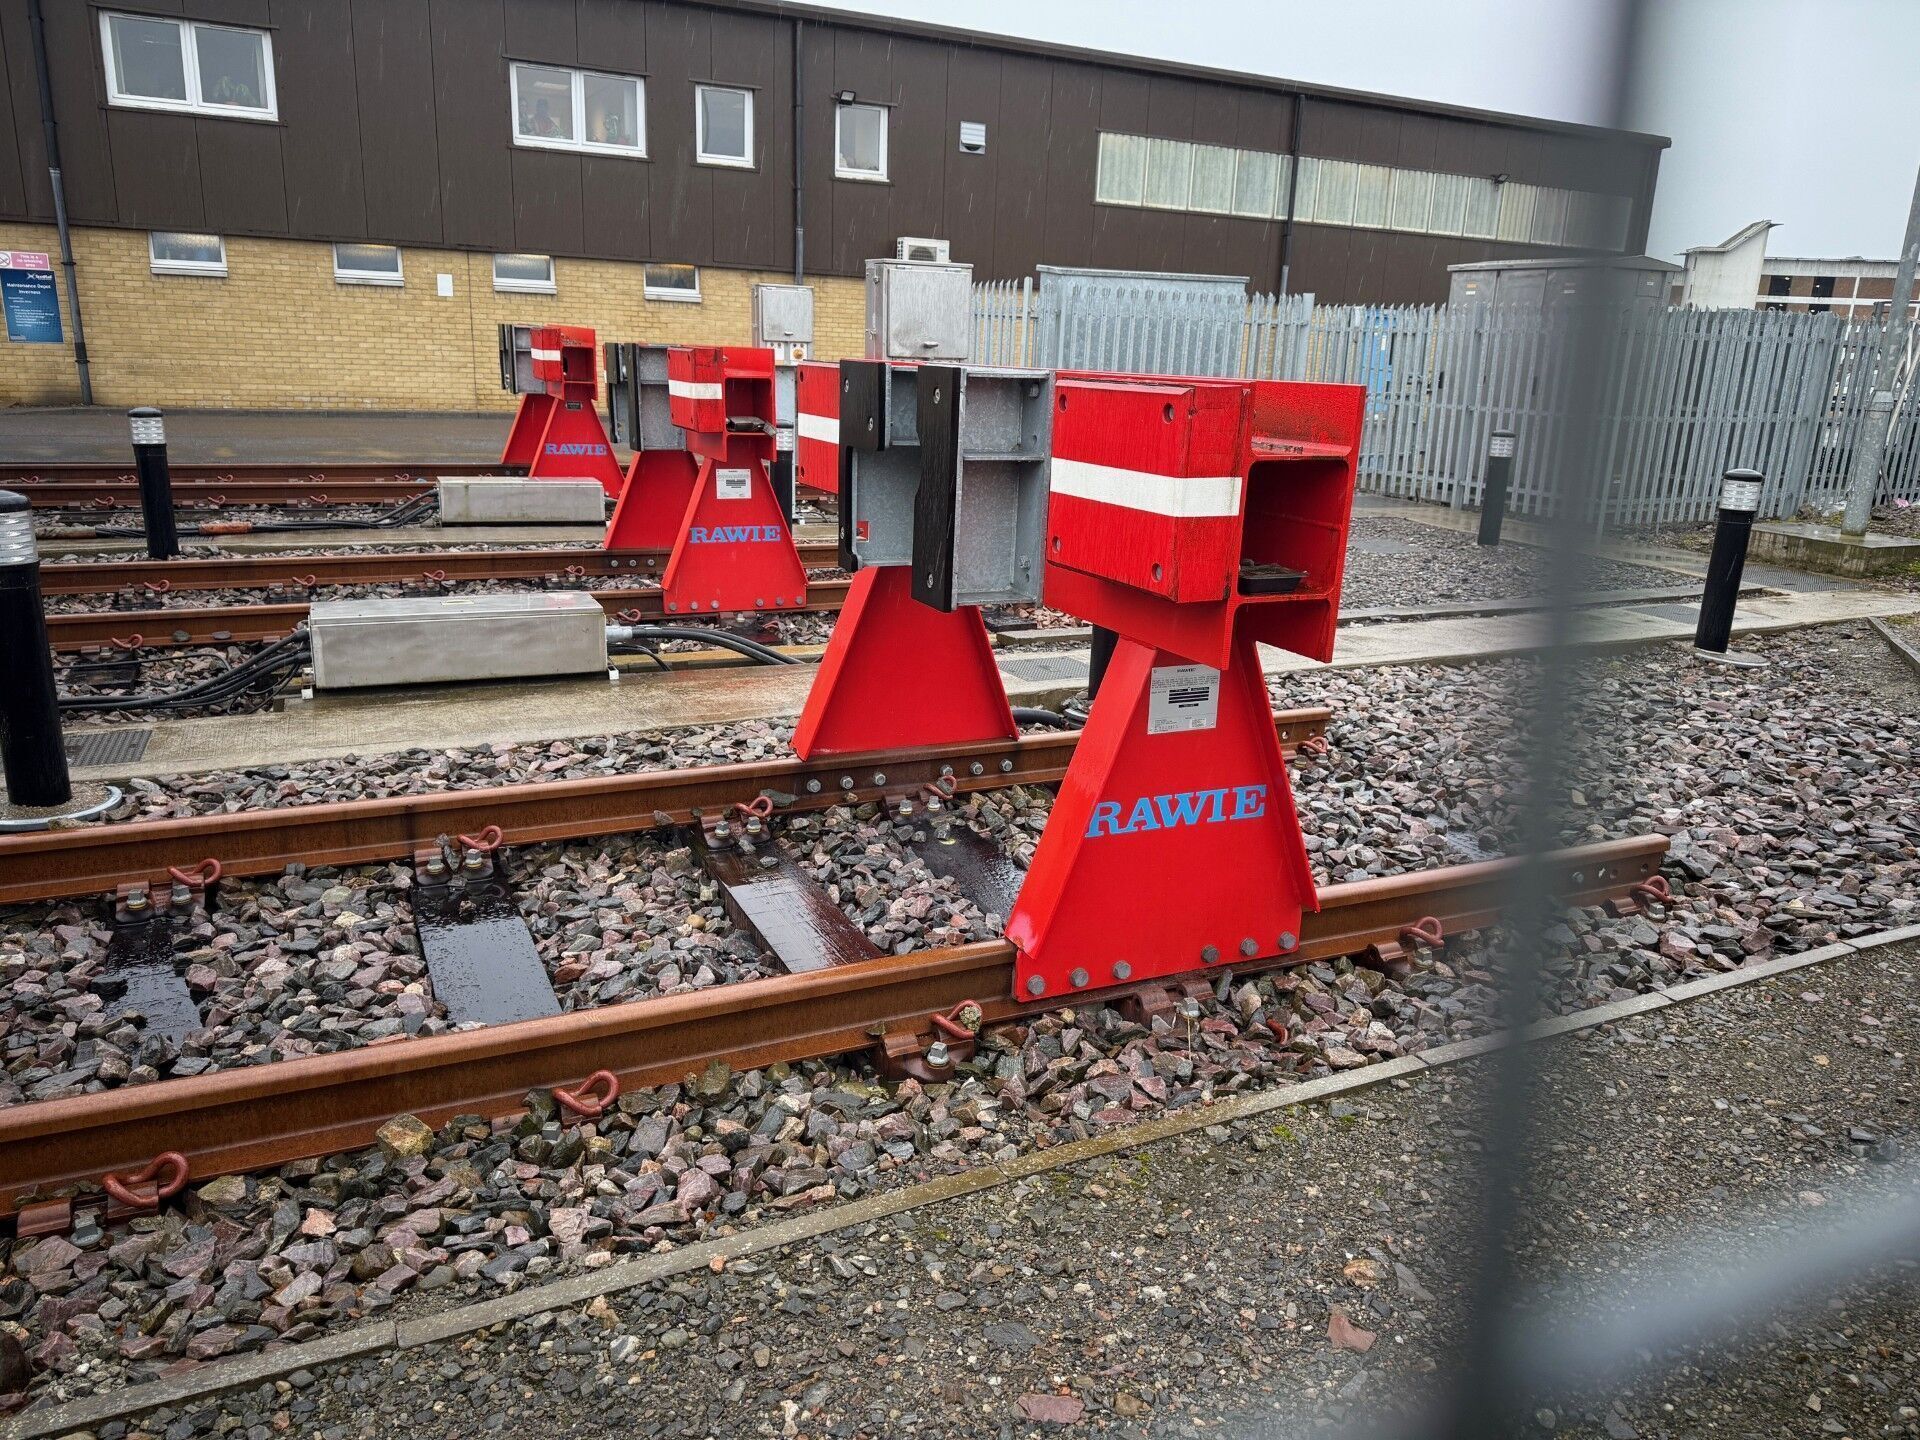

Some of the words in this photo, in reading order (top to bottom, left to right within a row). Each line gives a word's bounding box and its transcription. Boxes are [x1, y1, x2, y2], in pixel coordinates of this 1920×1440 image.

[544, 443, 608, 456] RAWIE
[689, 525, 781, 544] RAWIE
[1085, 784, 1267, 838] RAWIE
